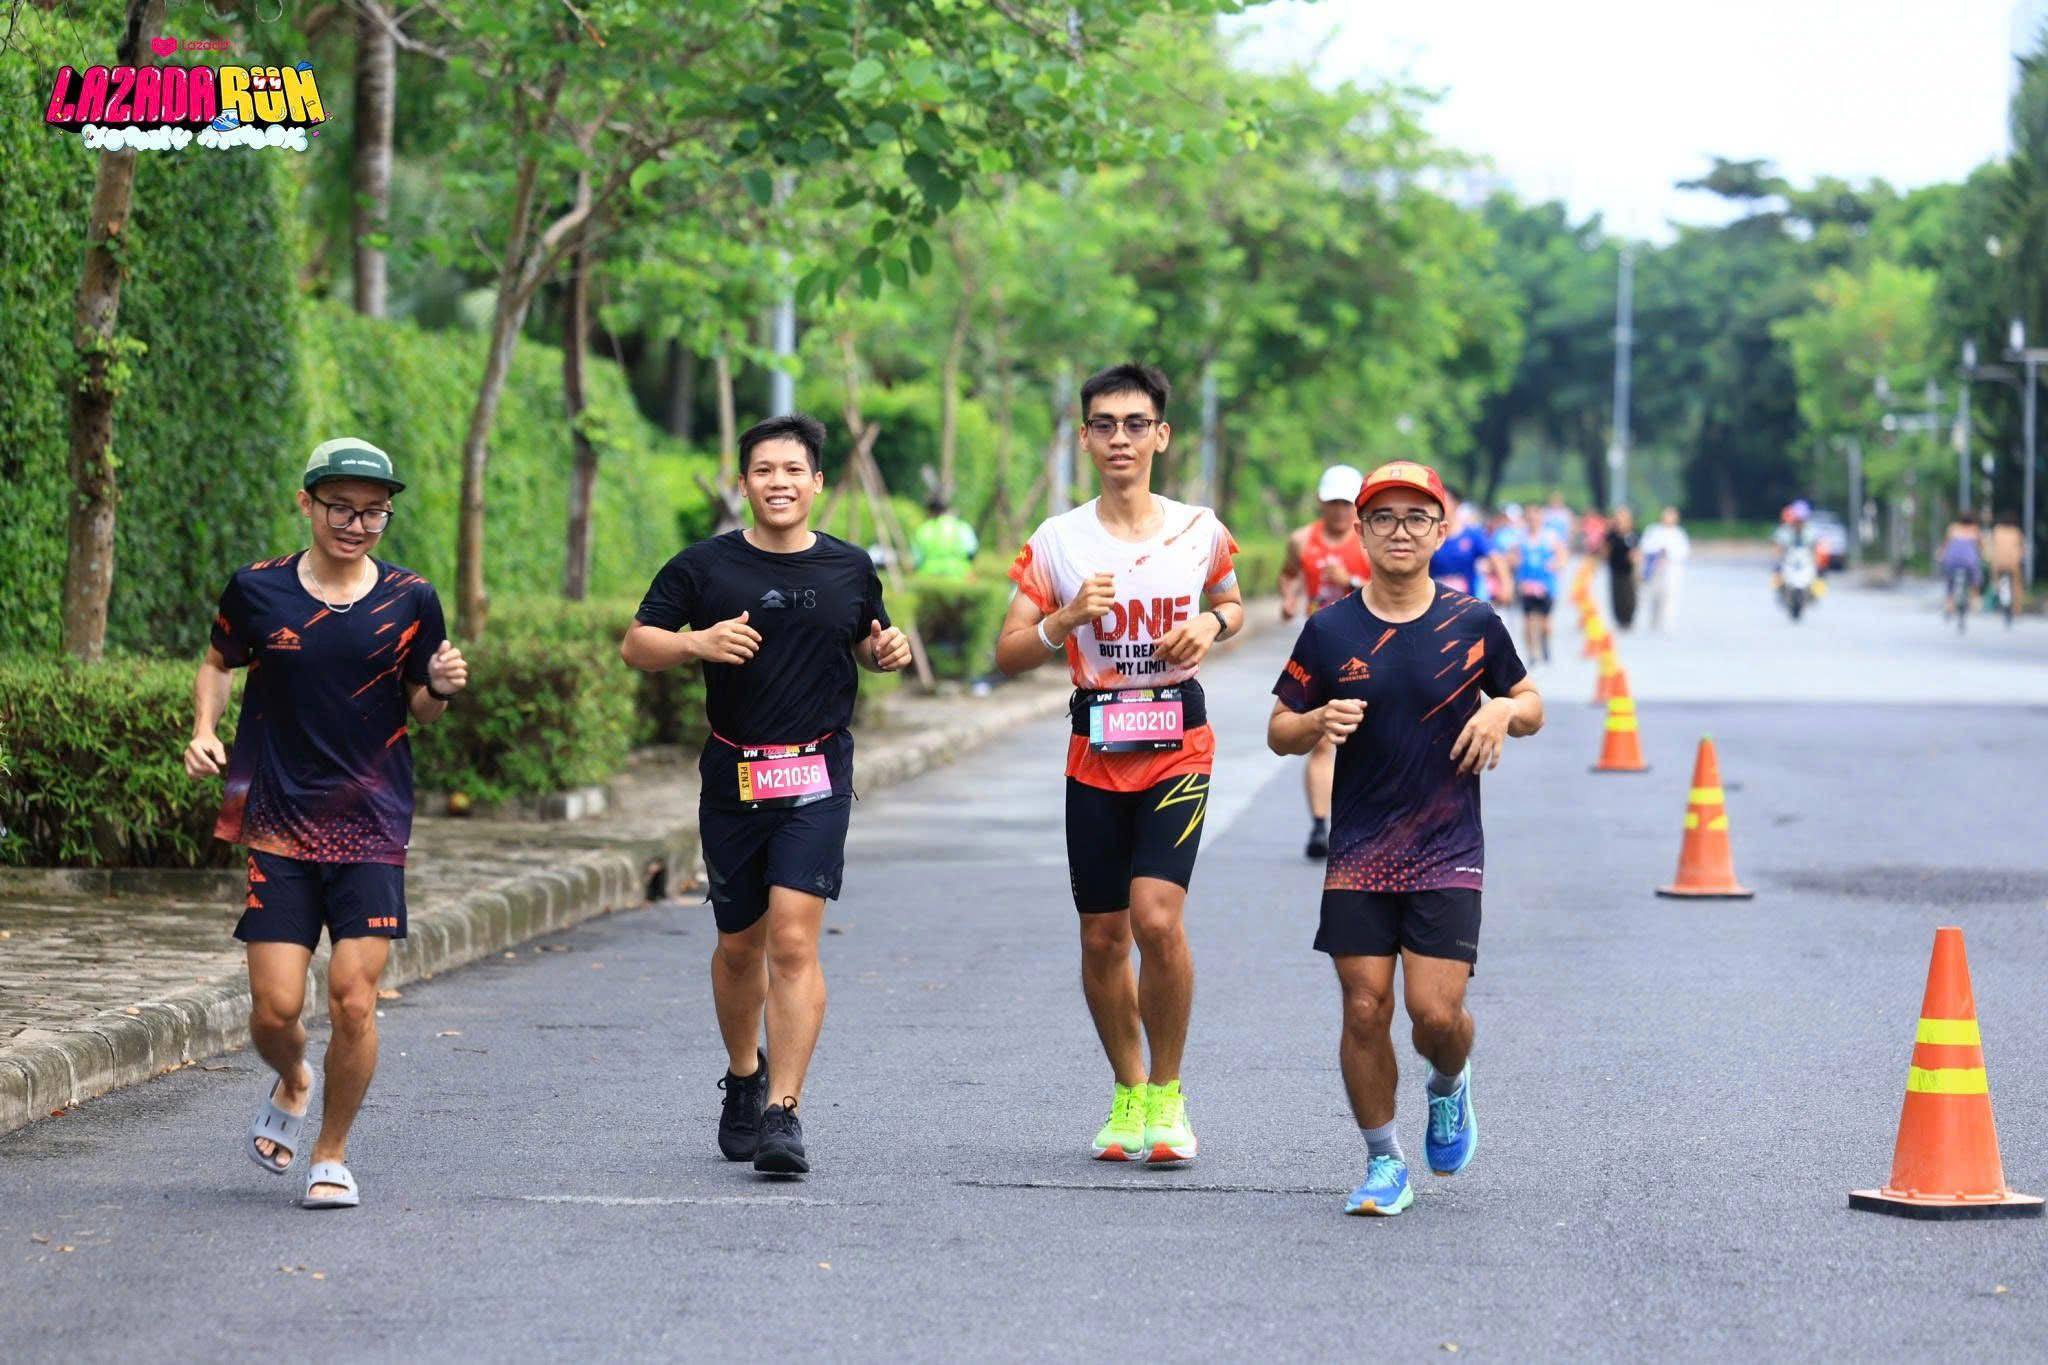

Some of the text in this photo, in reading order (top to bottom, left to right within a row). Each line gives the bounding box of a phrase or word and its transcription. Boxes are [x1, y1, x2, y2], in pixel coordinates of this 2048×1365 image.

[787, 588, 816, 609] T8
[1092, 595, 1190, 641] DNF
[1099, 643, 1159, 658] BUT I REA
[1116, 660, 1168, 676] MY LIMIT
[1108, 710, 1177, 733] M20210
[756, 765, 822, 790] M21036
